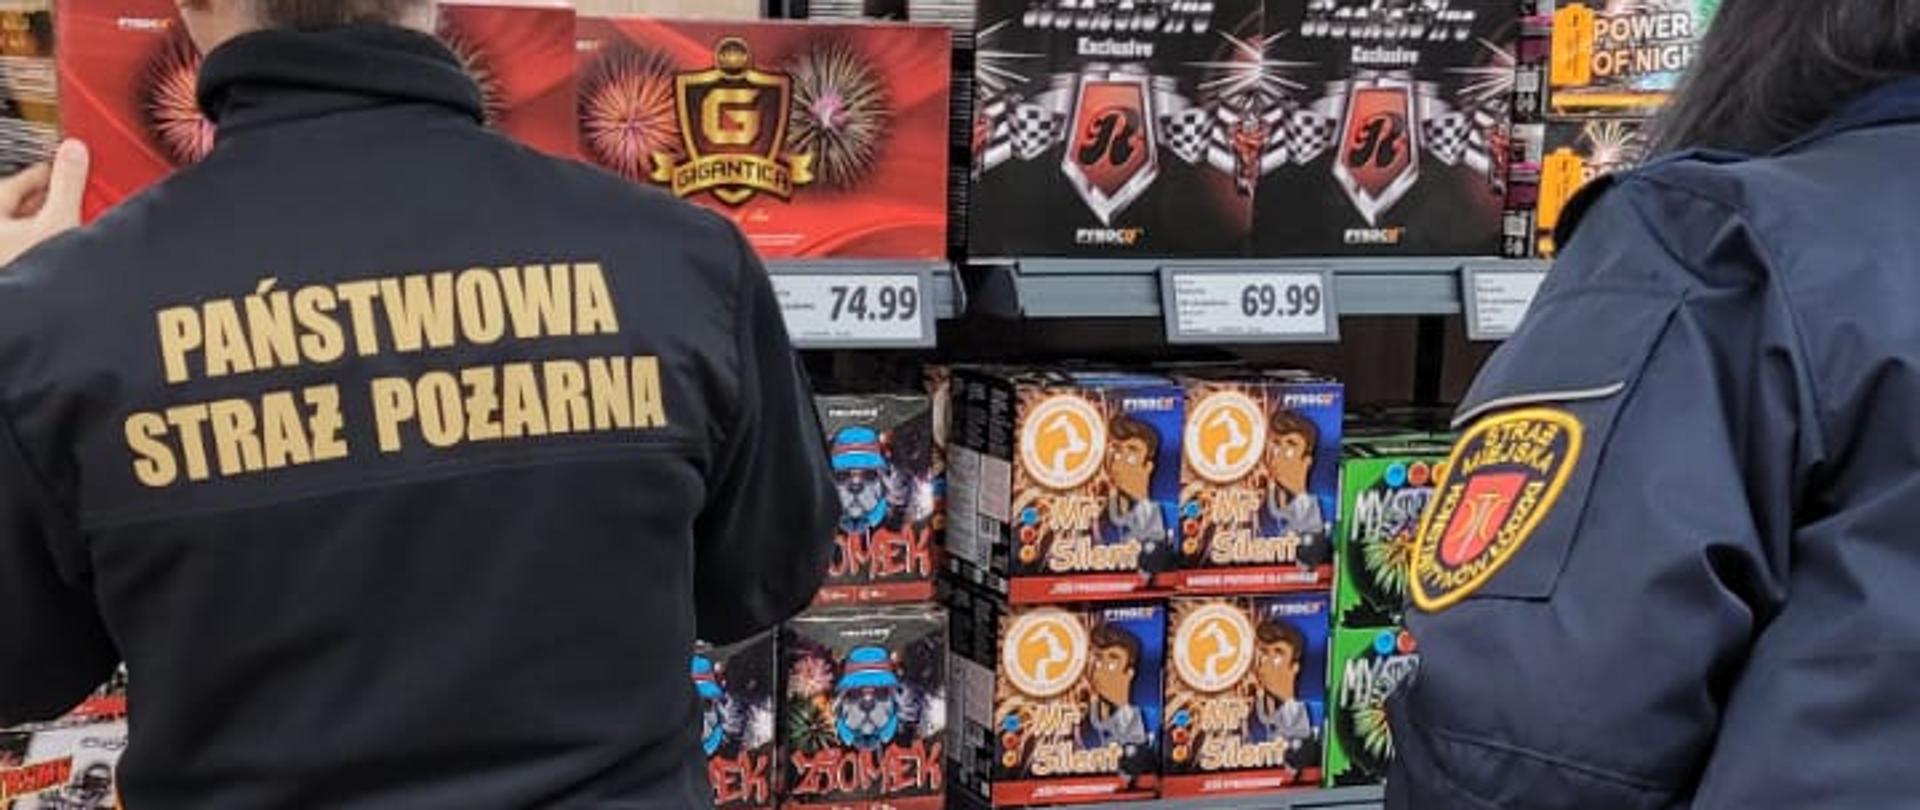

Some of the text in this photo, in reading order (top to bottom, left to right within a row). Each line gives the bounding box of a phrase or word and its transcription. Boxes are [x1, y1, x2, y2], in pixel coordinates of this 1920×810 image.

[1593, 12, 1690, 42] POWER
[1077, 37, 1154, 57] Exclusive
[1351, 45, 1420, 65] Exclusive
[1592, 45, 1693, 77] OF NIGH
[701, 88, 759, 145] G
[1079, 106, 1140, 166] R
[1349, 109, 1405, 169] R
[677, 160, 790, 194] GIGANTICA
[831, 285, 918, 322] 74.99
[1241, 283, 1321, 317] 69.99
[157, 263, 619, 384] PAŃSTWOWA
[125, 355, 667, 487] STRAŻ POŻARNA
[1461, 441, 1554, 476] MIEJSKA
[1049, 494, 1099, 530] Mr
[1211, 488, 1259, 525] Mr
[1049, 534, 1142, 573] Silent
[1210, 529, 1301, 565] Silent
[1034, 701, 1081, 737] Mr
[1200, 698, 1249, 732] Mr
[1031, 741, 1123, 775] Silent
[1200, 736, 1289, 771] Silent
